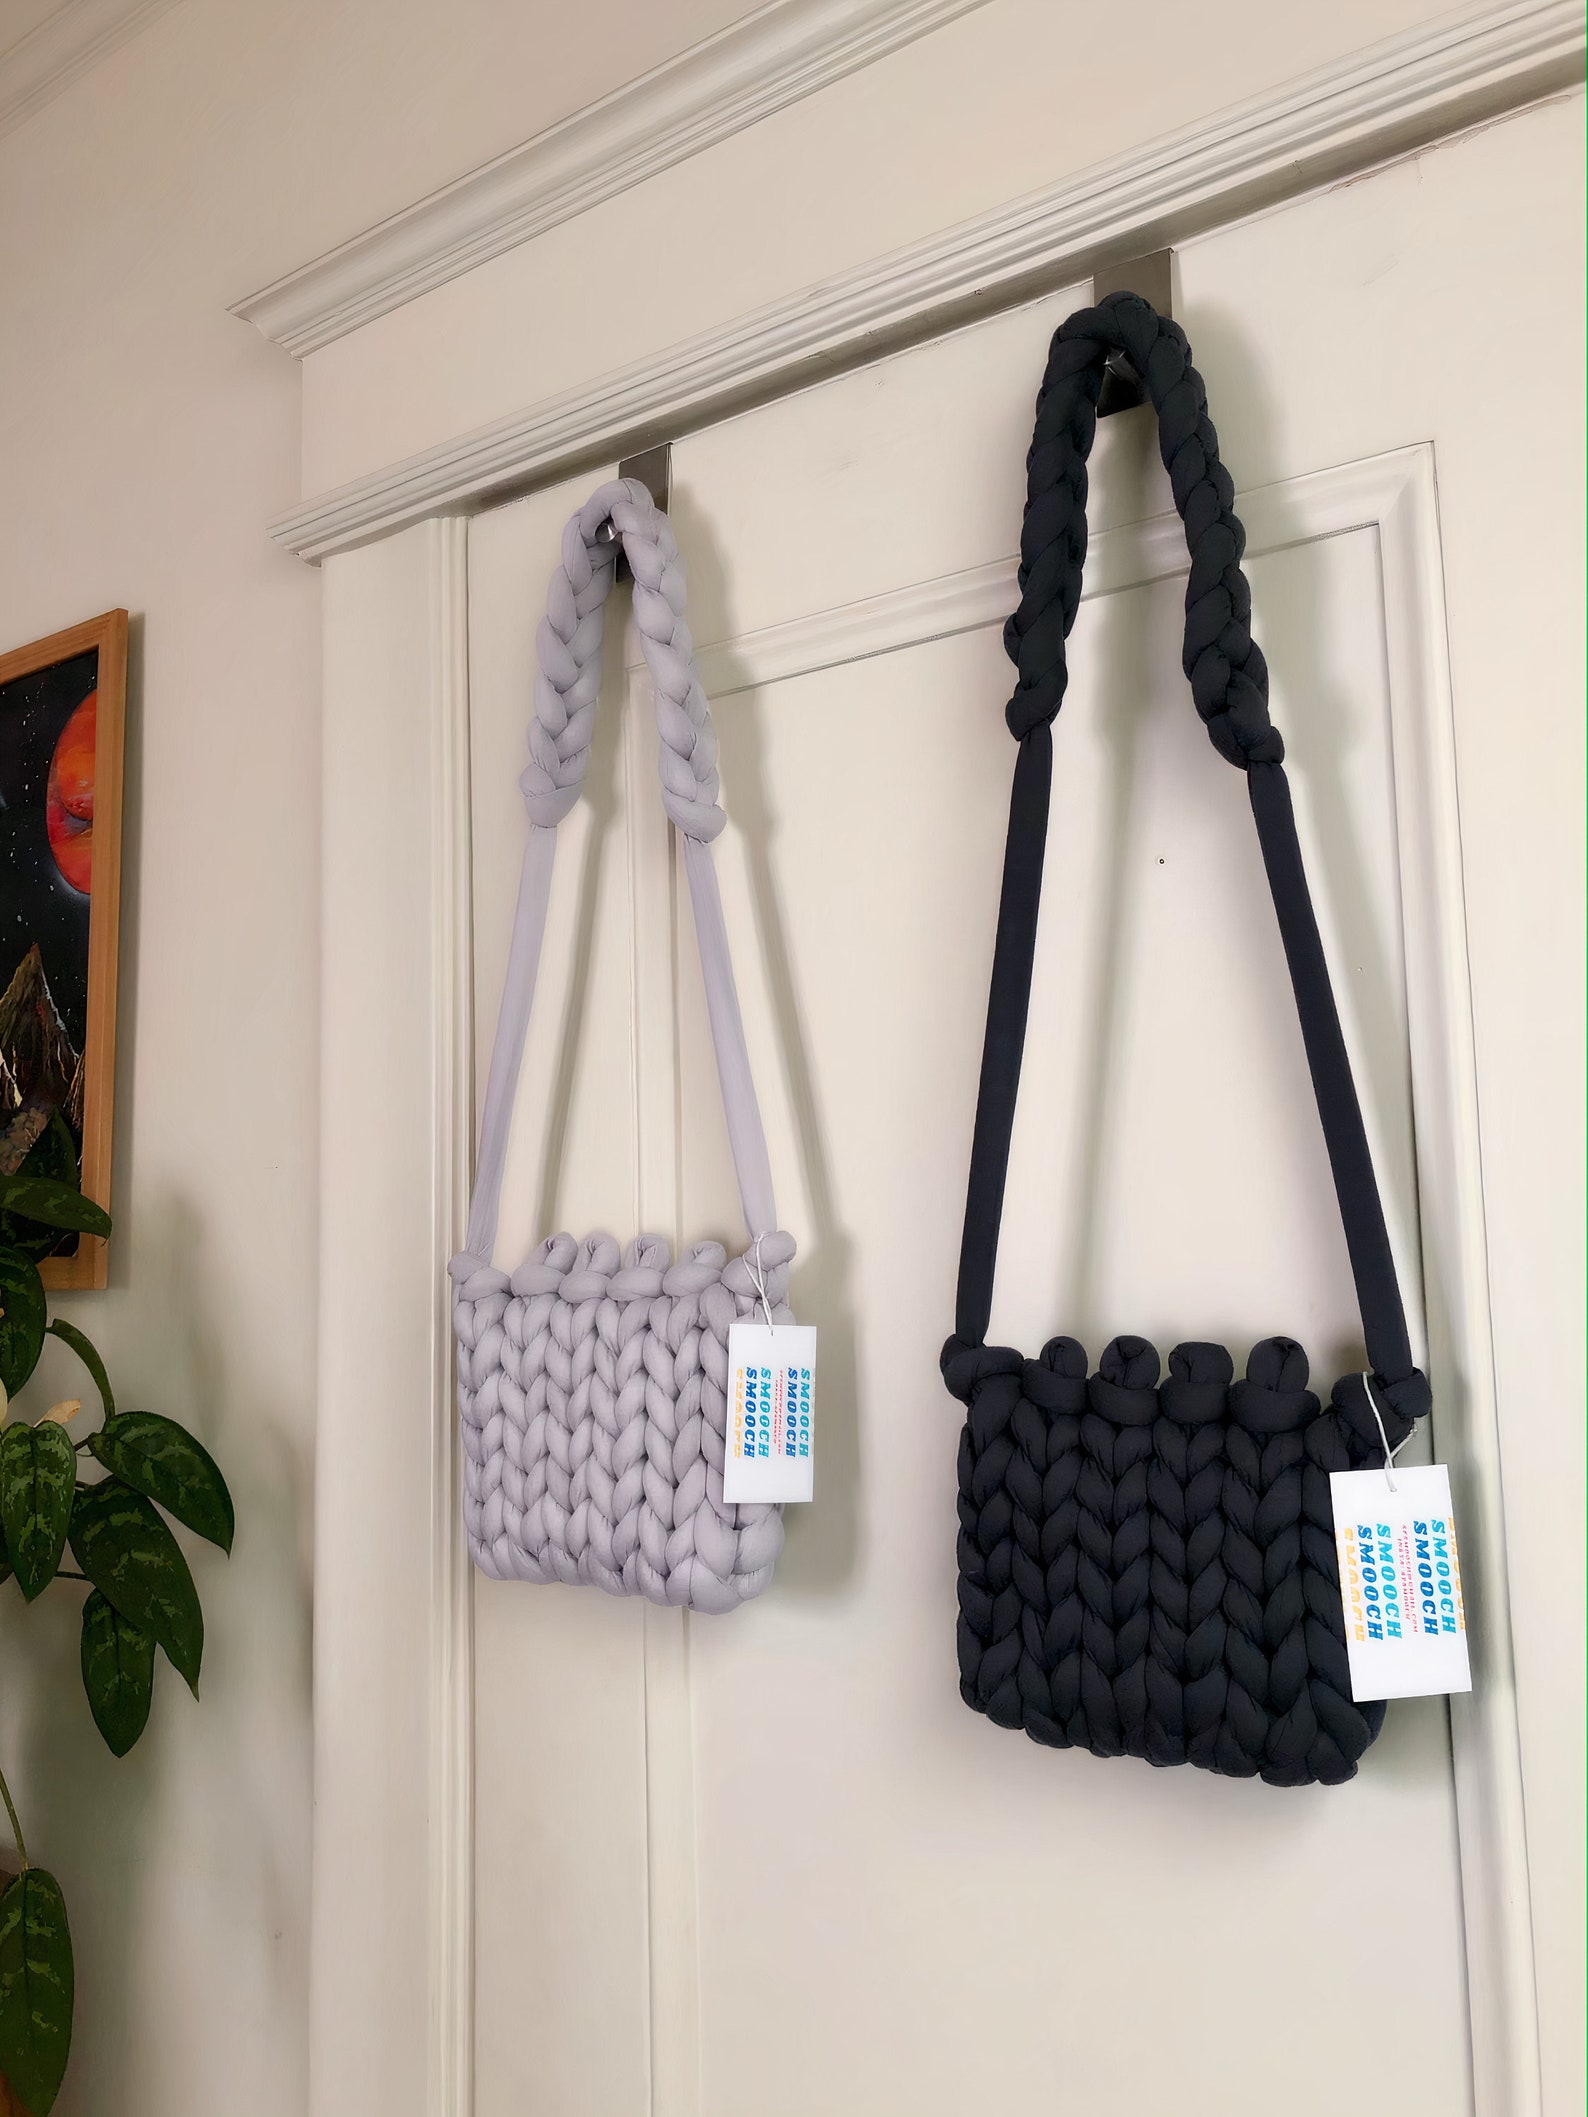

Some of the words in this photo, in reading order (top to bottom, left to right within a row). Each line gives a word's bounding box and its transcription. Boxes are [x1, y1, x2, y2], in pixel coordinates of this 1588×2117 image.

[744, 1367, 757, 1457] SMOOCH
[758, 1367, 771, 1457] SMOOCH
[786, 1367, 797, 1457] SMOOCH
[799, 1368, 810, 1457] SMOOCH
[1357, 1524, 1384, 1641] SMOOCH
[1376, 1523, 1402, 1639] SMOOCH
[1413, 1520, 1439, 1636] SMOOCH
[1431, 1519, 1457, 1634] SMOOCH
